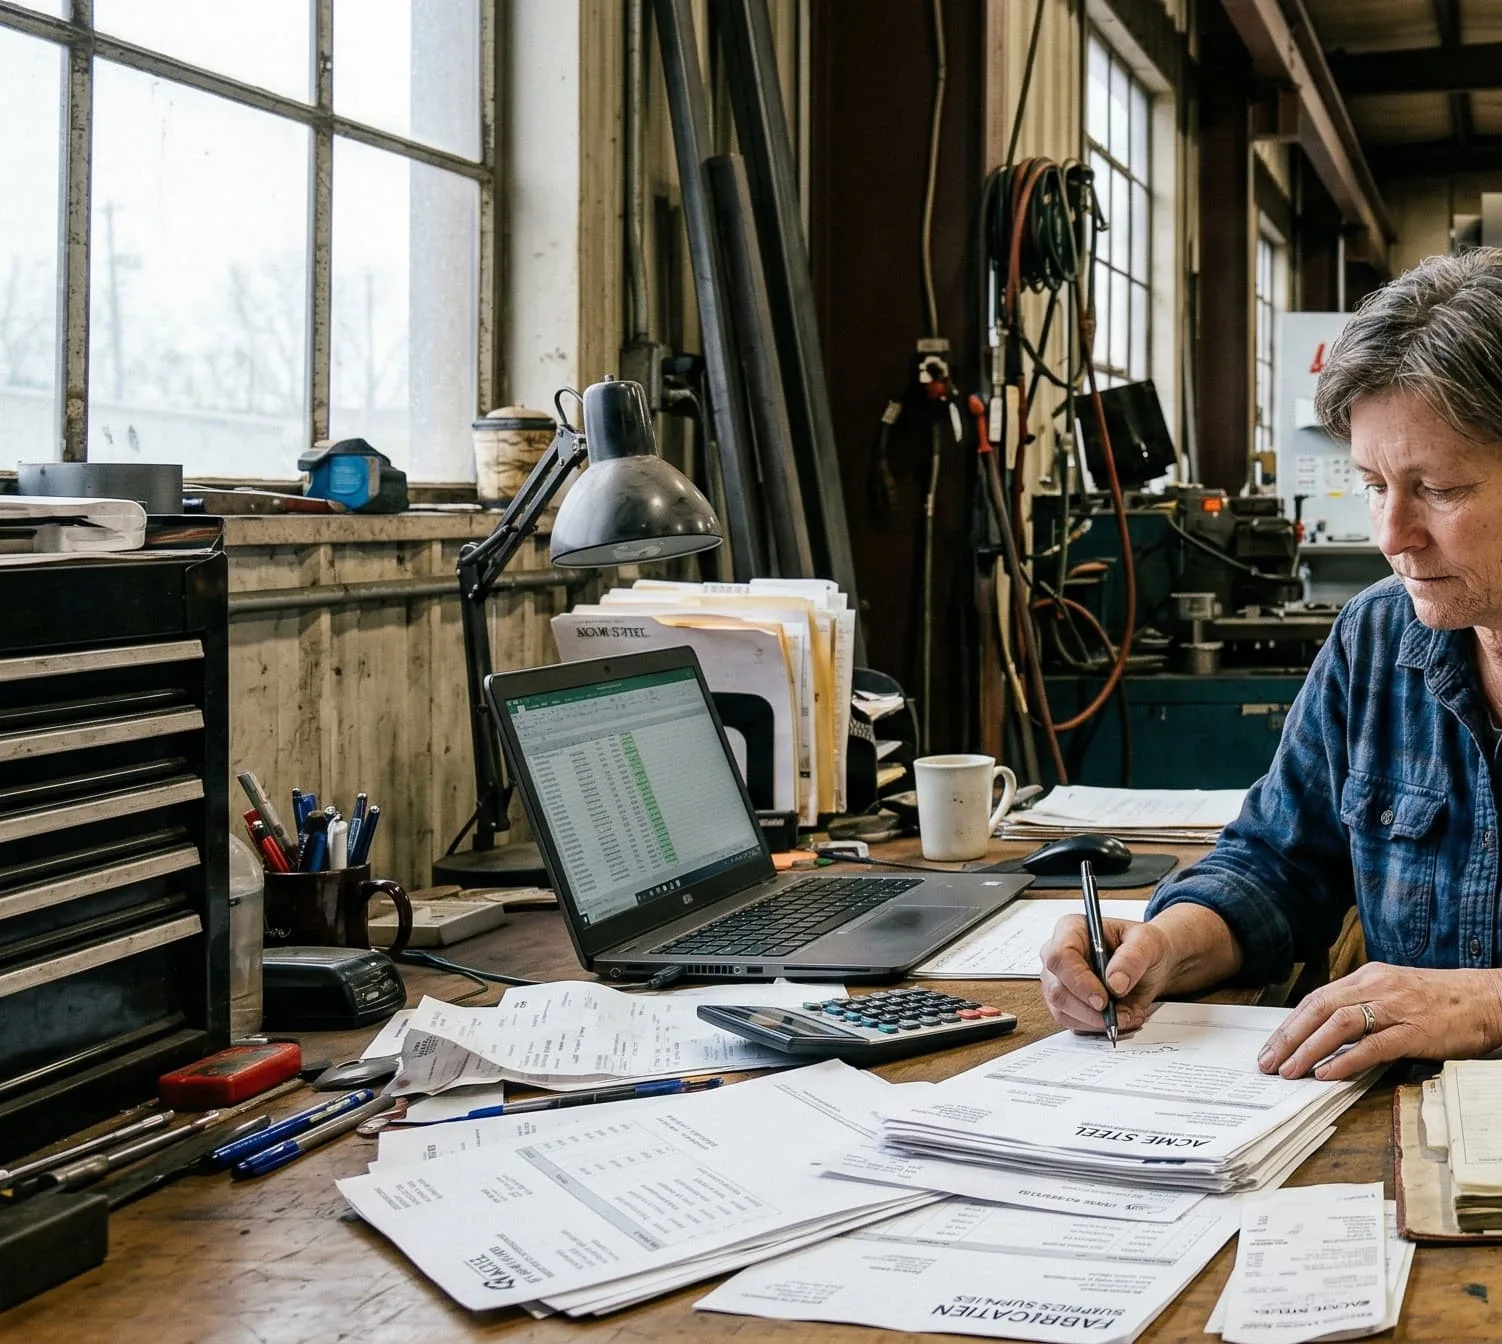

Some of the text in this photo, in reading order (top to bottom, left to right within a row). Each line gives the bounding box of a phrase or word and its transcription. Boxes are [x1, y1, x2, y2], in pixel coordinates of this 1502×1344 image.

[1075, 1126, 1139, 1142] STEEL
[1141, 1135, 1212, 1148] ACME
[931, 1303, 1116, 1329] FABRICATIEN
